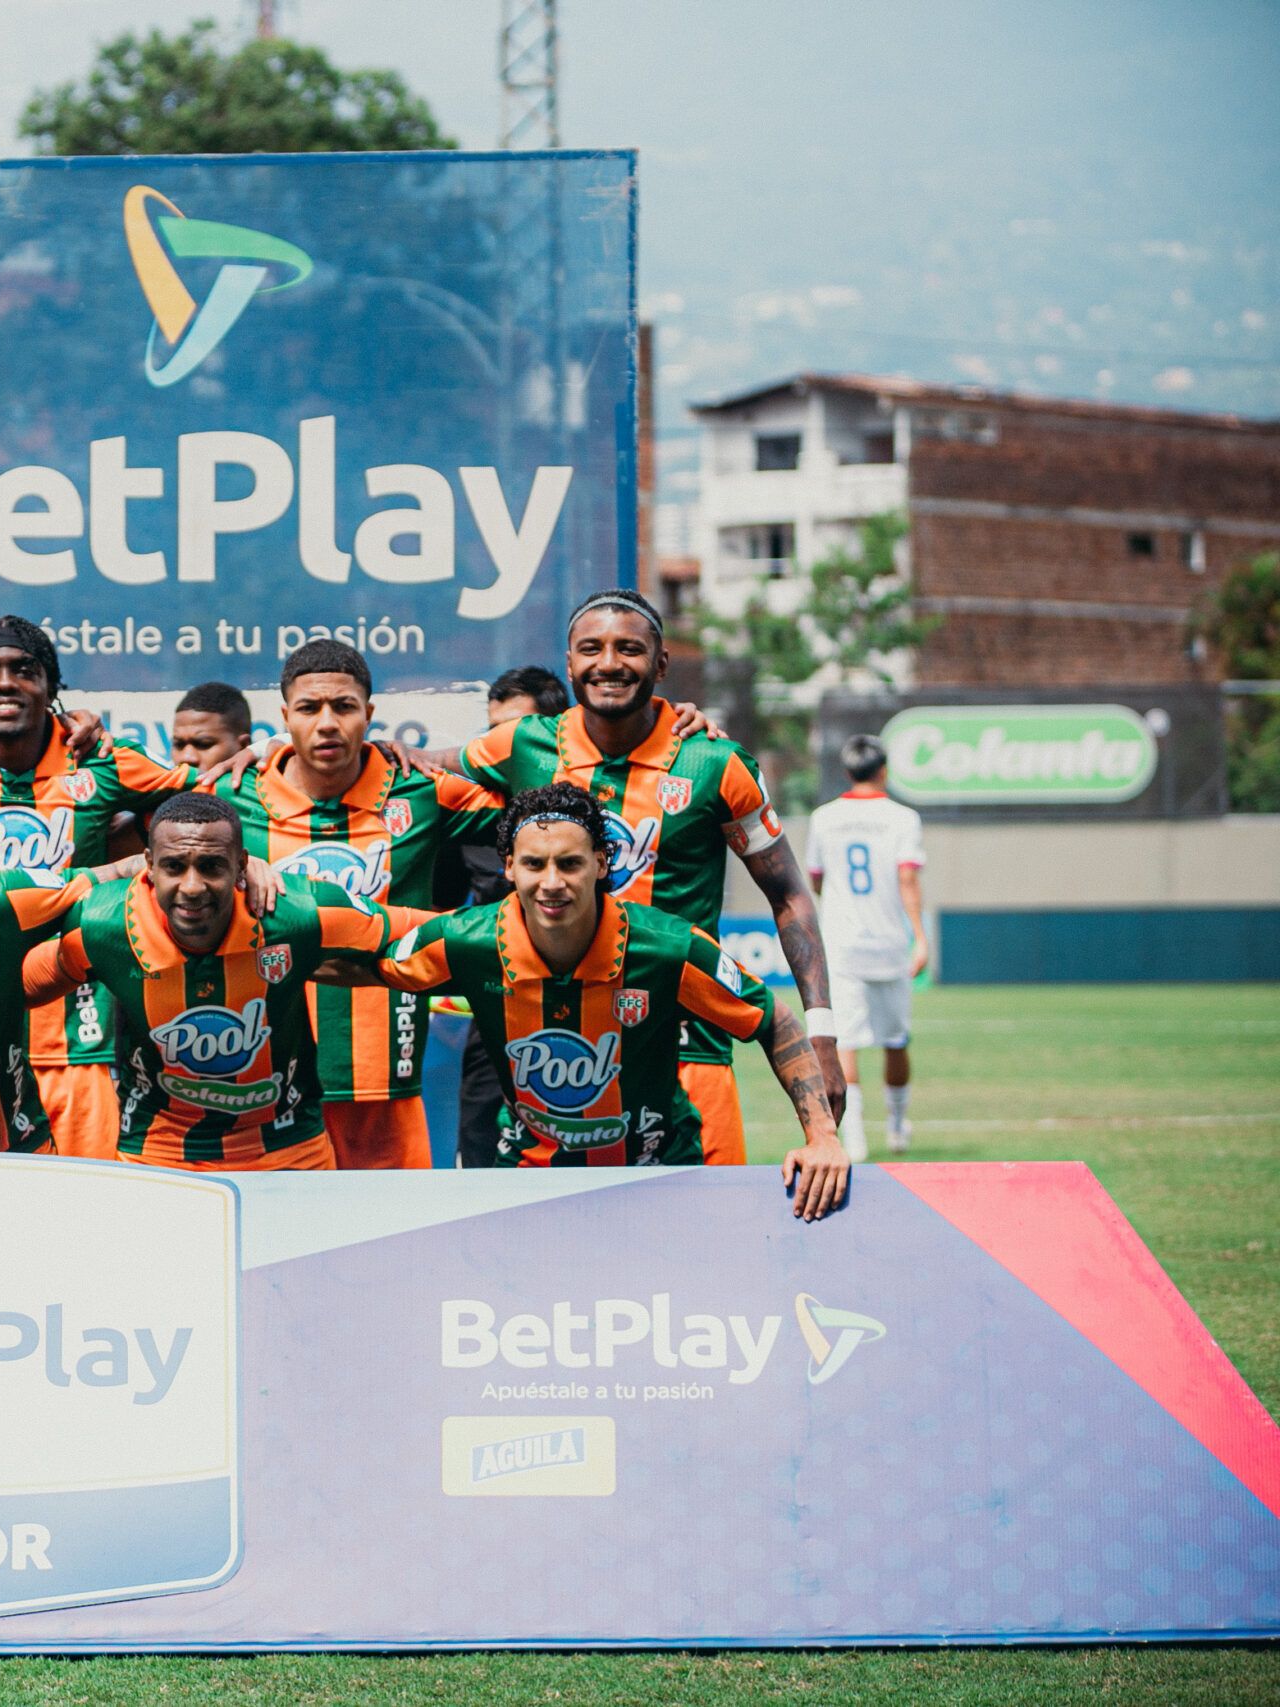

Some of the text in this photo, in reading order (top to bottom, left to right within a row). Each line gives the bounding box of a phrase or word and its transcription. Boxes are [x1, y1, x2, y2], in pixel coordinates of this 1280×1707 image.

[176, 627, 202, 654] a
[217, 618, 262, 654] tu
[888, 724, 1143, 783] Colanta
[663, 783, 685, 796] EFC
[847, 843, 873, 895] 8
[262, 953, 286, 966] EFC
[617, 997, 643, 1009] EFC
[154, 998, 268, 1063] Pool
[395, 991, 417, 1078] BetPla
[506, 1032, 620, 1088] Pool
[162, 1075, 275, 1107] Colanta
[523, 1109, 623, 1145] Colanta
[441, 1292, 782, 1385] BetPlay
[481, 1380, 714, 1401] Apuéstale a tu pasión
